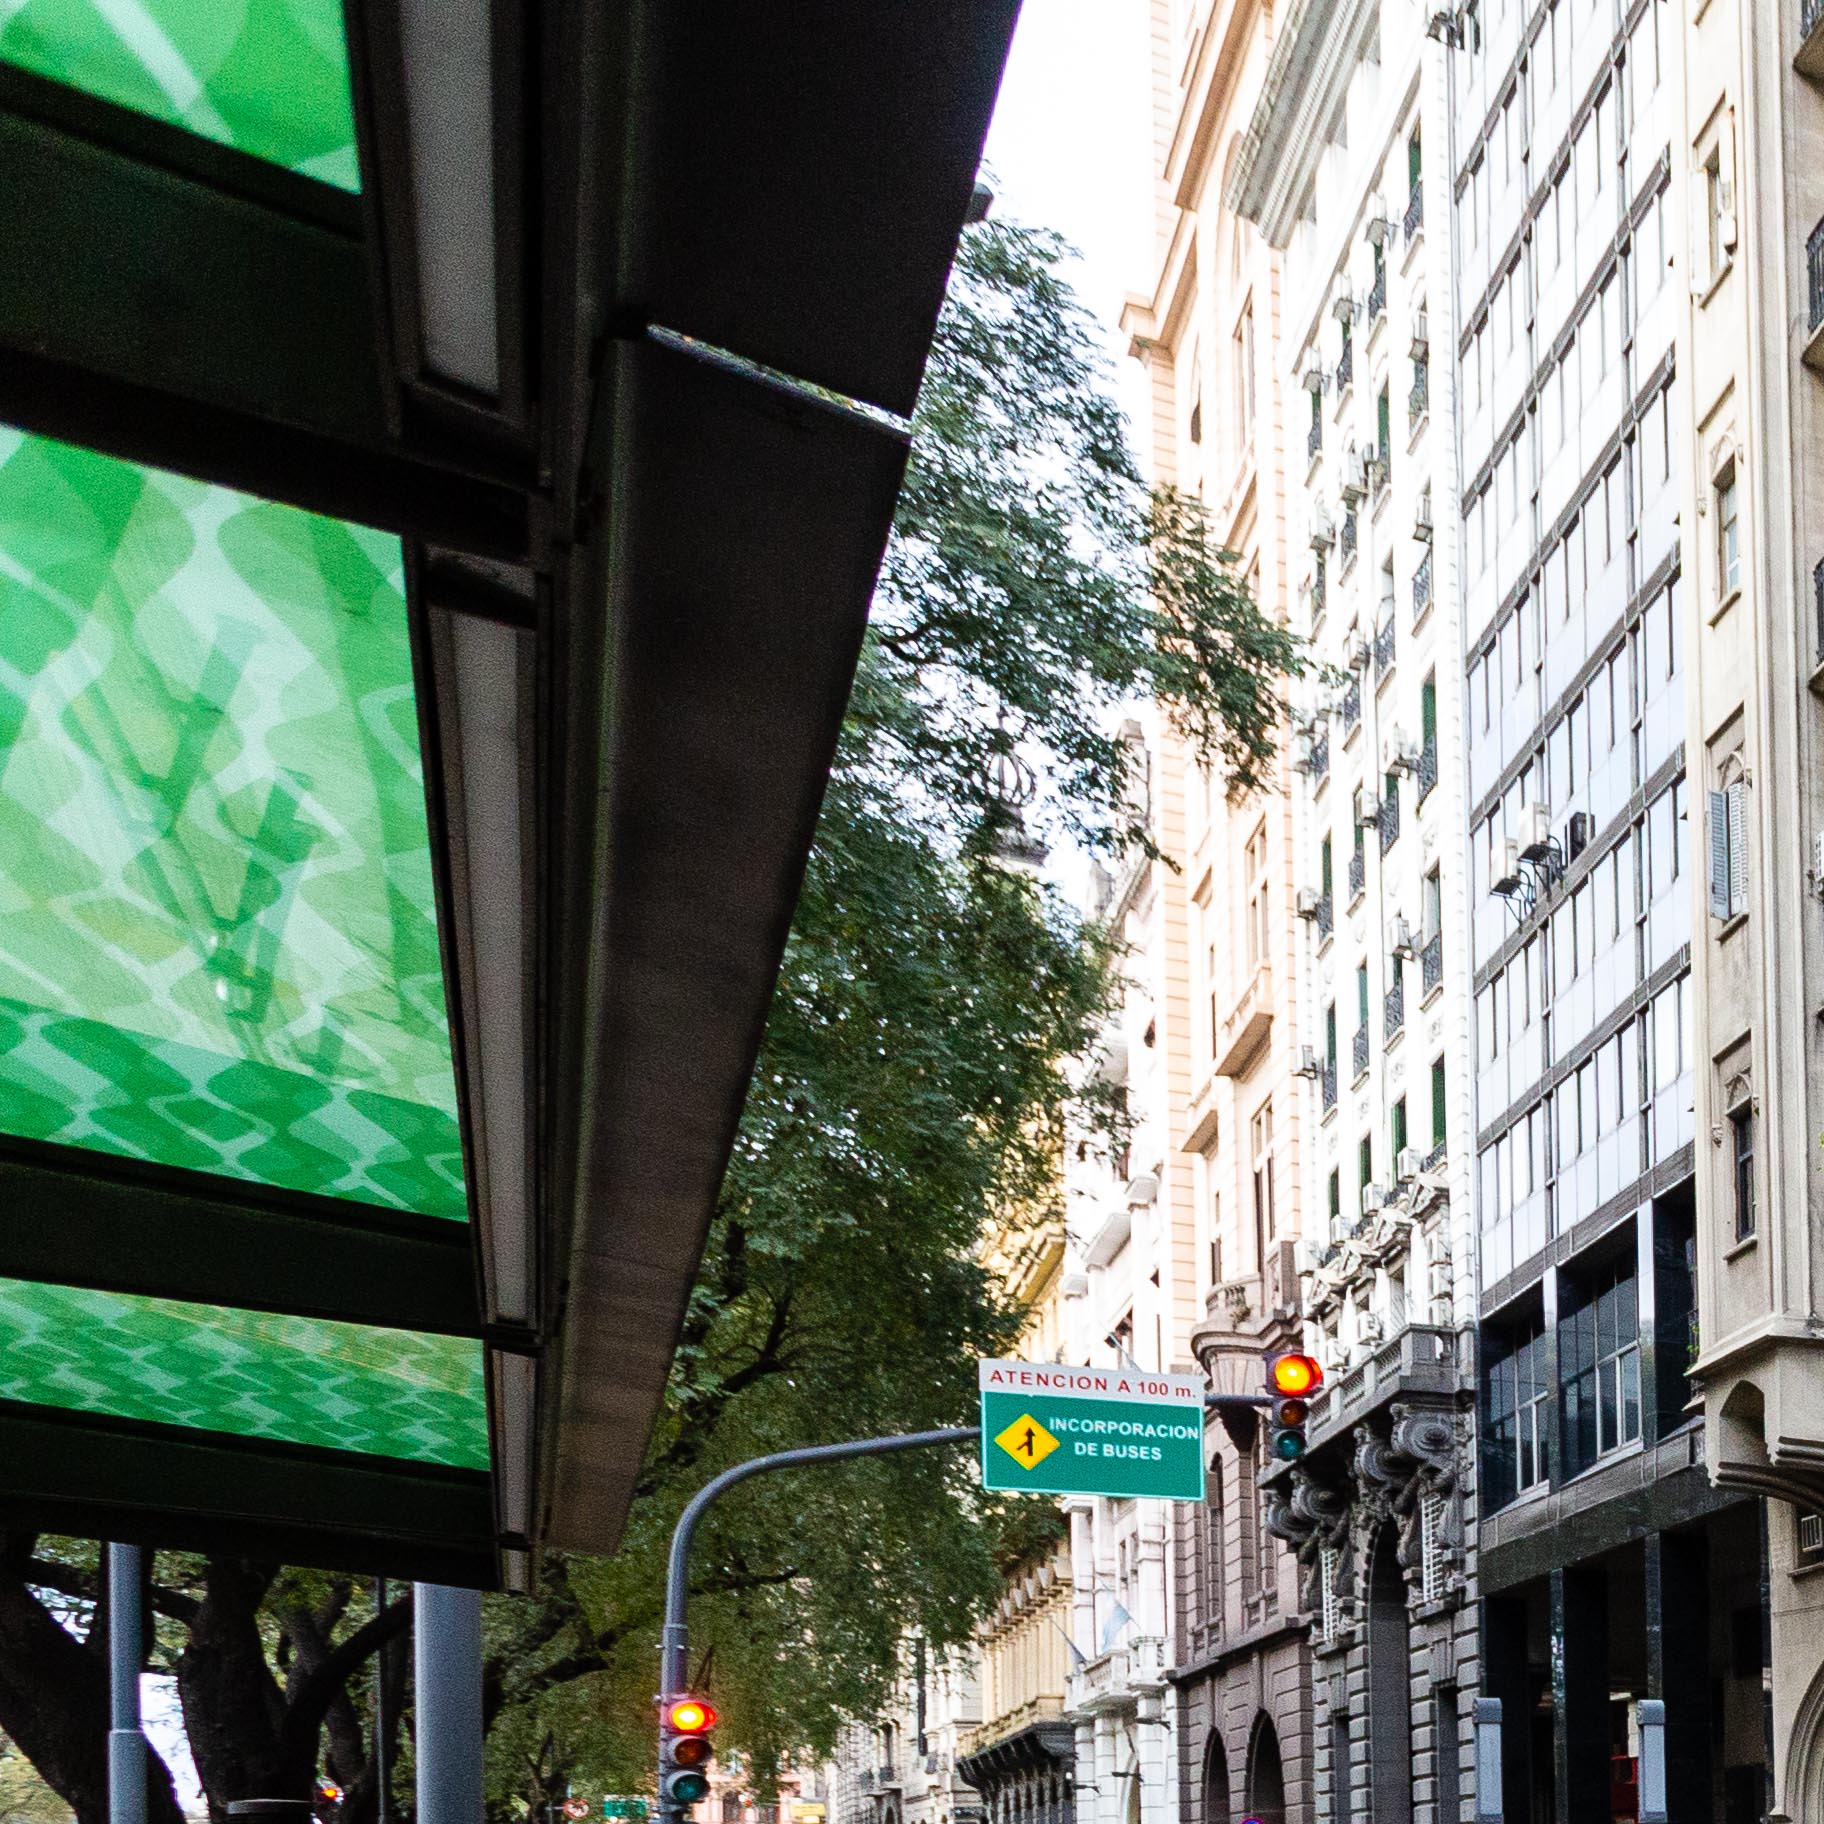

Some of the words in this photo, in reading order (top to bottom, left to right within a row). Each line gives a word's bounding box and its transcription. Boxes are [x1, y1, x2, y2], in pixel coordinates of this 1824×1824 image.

[989, 1369, 1108, 1391] ATENCION
[1117, 1379, 1131, 1394] A
[1138, 1381, 1169, 1397] 100
[1049, 1417, 1199, 1441] INCORPORACION
[1073, 1442, 1099, 1457] DE
[1102, 1443, 1163, 1461] BUSES
